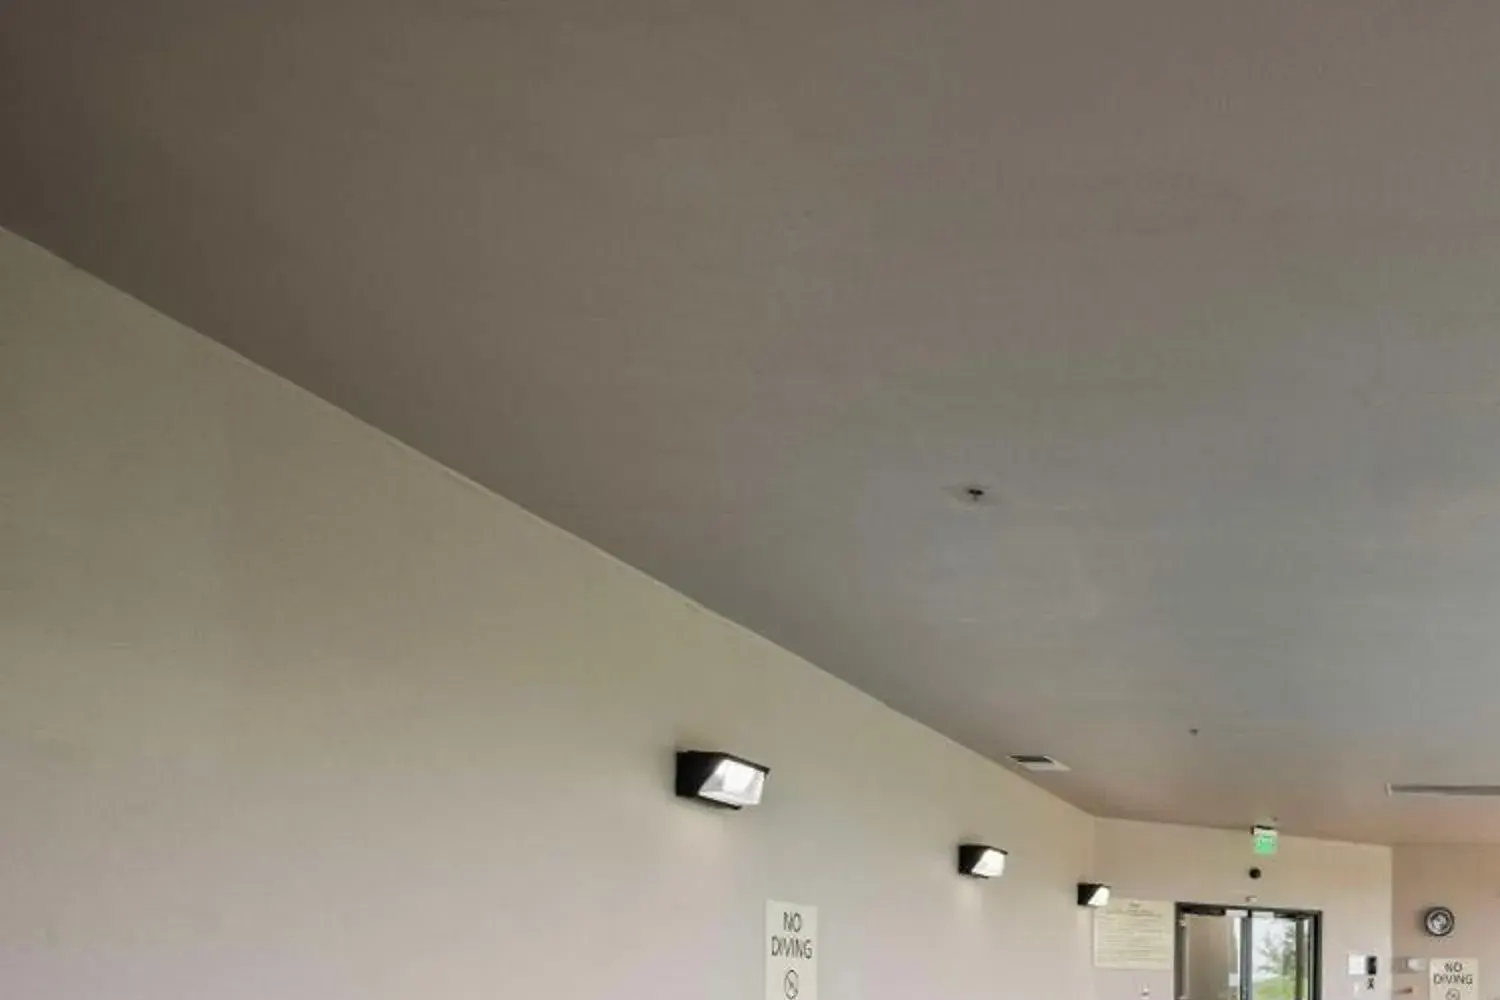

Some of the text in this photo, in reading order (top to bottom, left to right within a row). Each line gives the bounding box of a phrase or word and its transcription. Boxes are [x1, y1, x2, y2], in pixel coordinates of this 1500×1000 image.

[783, 911, 802, 933] NO
[771, 935, 813, 960] DIVING
[1443, 961, 1463, 973] NO
[1433, 973, 1474, 985] DIVING
